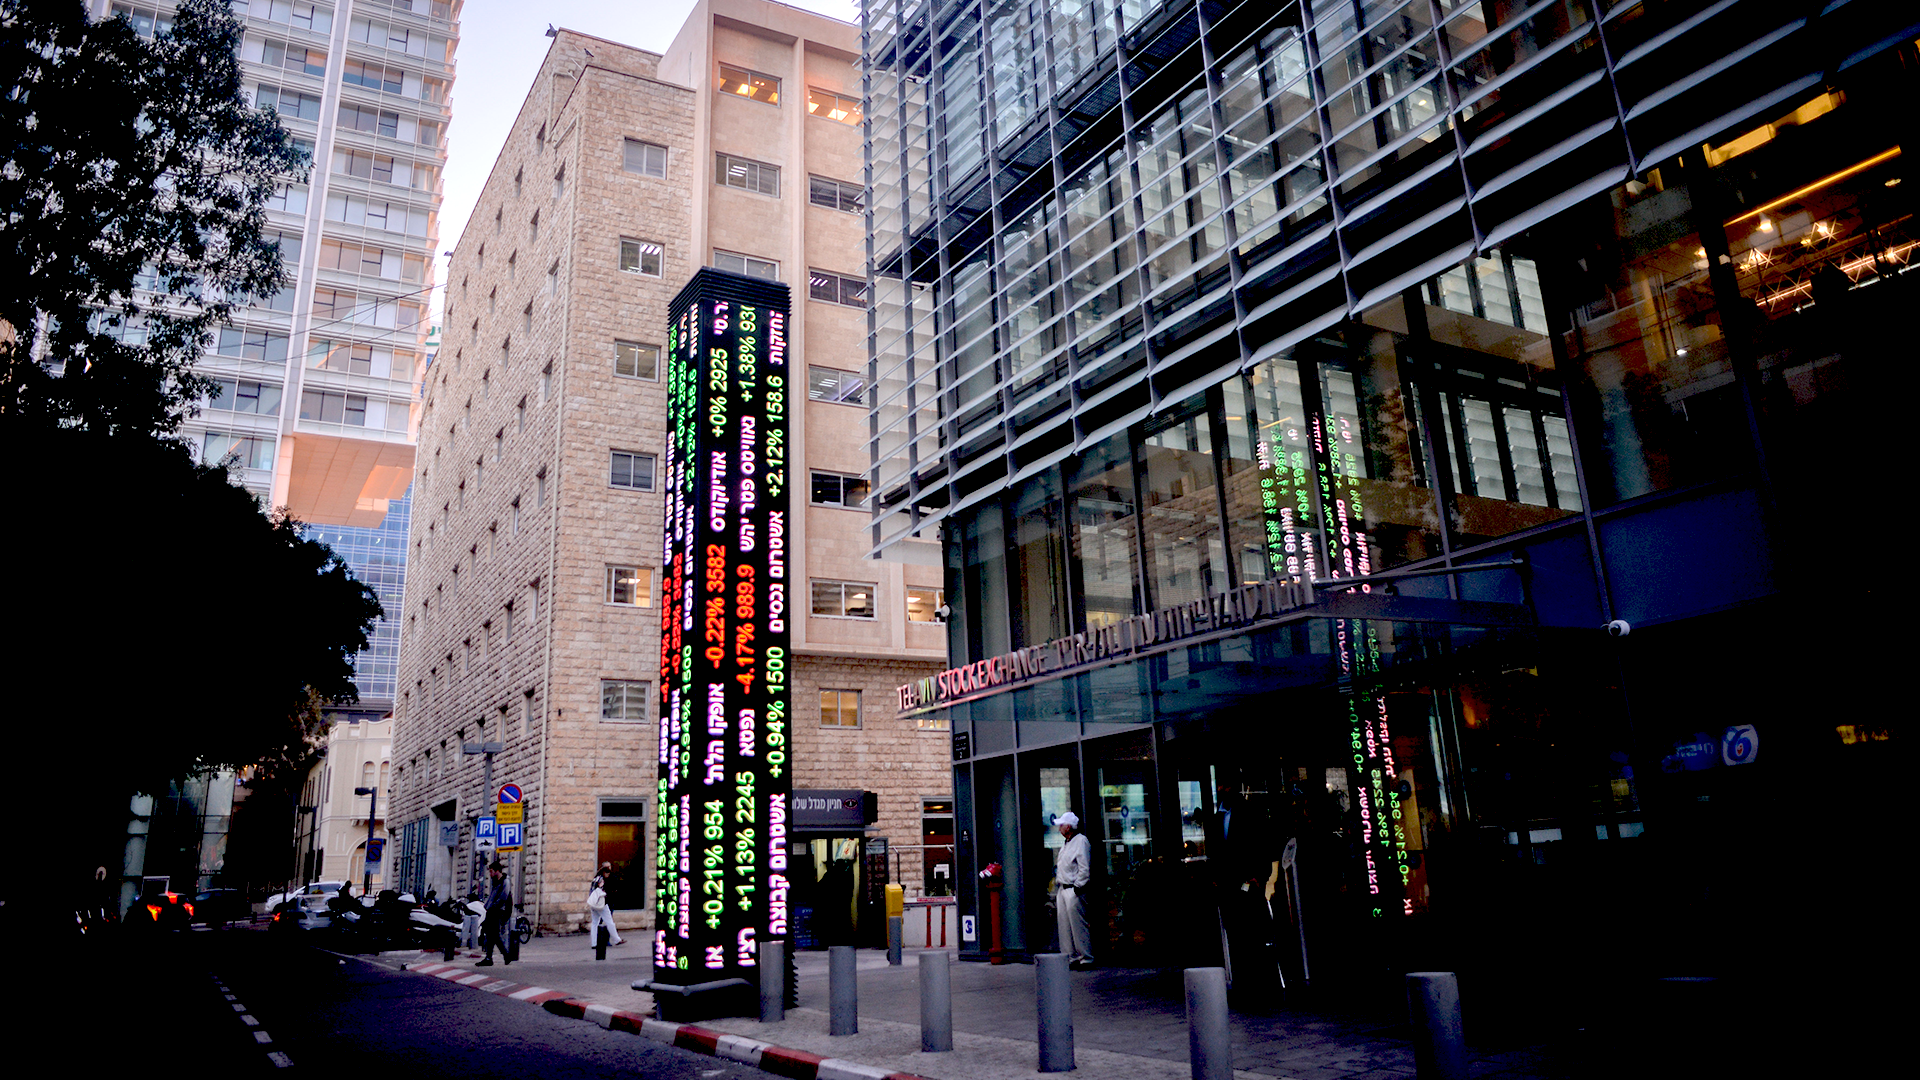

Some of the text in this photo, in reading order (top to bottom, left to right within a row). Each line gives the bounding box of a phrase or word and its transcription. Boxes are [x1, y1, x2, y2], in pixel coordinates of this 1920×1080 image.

[714, 300, 728, 335] ר.טי
[710, 348, 728, 392] 2925
[739, 336, 756, 402] +1.38%
[709, 396, 727, 437] +0%
[766, 375, 783, 422] 158.6
[740, 415, 755, 476] נאוויטס
[766, 429, 783, 497] +2.12%
[710, 451, 729, 532] אודיוקודס
[740, 478, 755, 515] פטר
[740, 517, 755, 552] יהש
[769, 511, 783, 578] אשטרום
[706, 544, 726, 593] 3582
[736, 564, 755, 619] 989.9
[705, 597, 725, 669] -0.22%
[769, 583, 784, 633] נכסים
[736, 623, 755, 694] -4.17%
[766, 646, 784, 694] 1500
[938, 662, 979, 699] STOCK
[977, 642, 1048, 688] EXCHANGE
[707, 683, 728, 735] אופקו
[739, 708, 755, 757] נפטא
[766, 701, 785, 778] +0.94%
[704, 799, 724, 840] 954
[736, 771, 755, 823] 2245
[808, 796, 826, 810] מגדל
[827, 798, 842, 812] חניון
[769, 793, 787, 870] אשטרום
[703, 845, 724, 929] +0.21%
[735, 828, 755, 911] +1.13%
[769, 874, 790, 934] קבוצה
[737, 927, 756, 967] רציו
